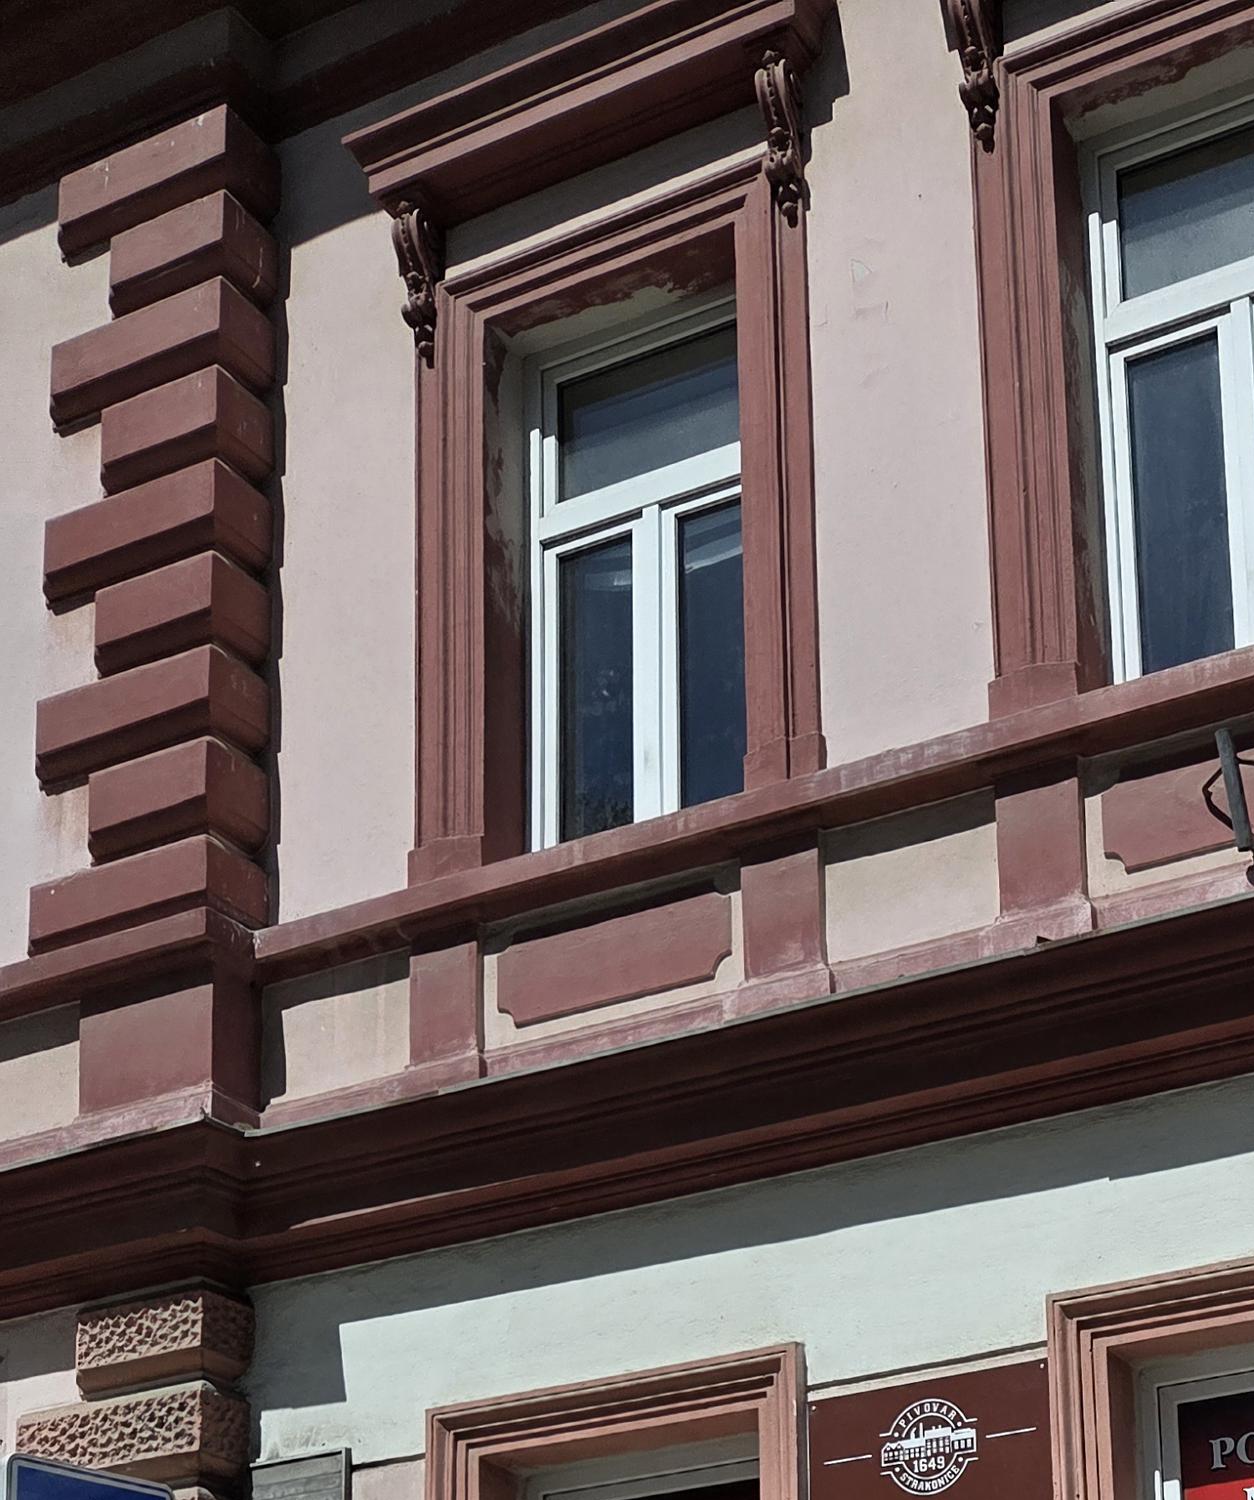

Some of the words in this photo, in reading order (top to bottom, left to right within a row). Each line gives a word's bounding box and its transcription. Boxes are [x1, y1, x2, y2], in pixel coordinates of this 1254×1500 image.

[899, 1403, 957, 1428] PIVOVAR
[913, 1455, 945, 1473] 1649
[900, 1465, 960, 1491] STRAKONICE
